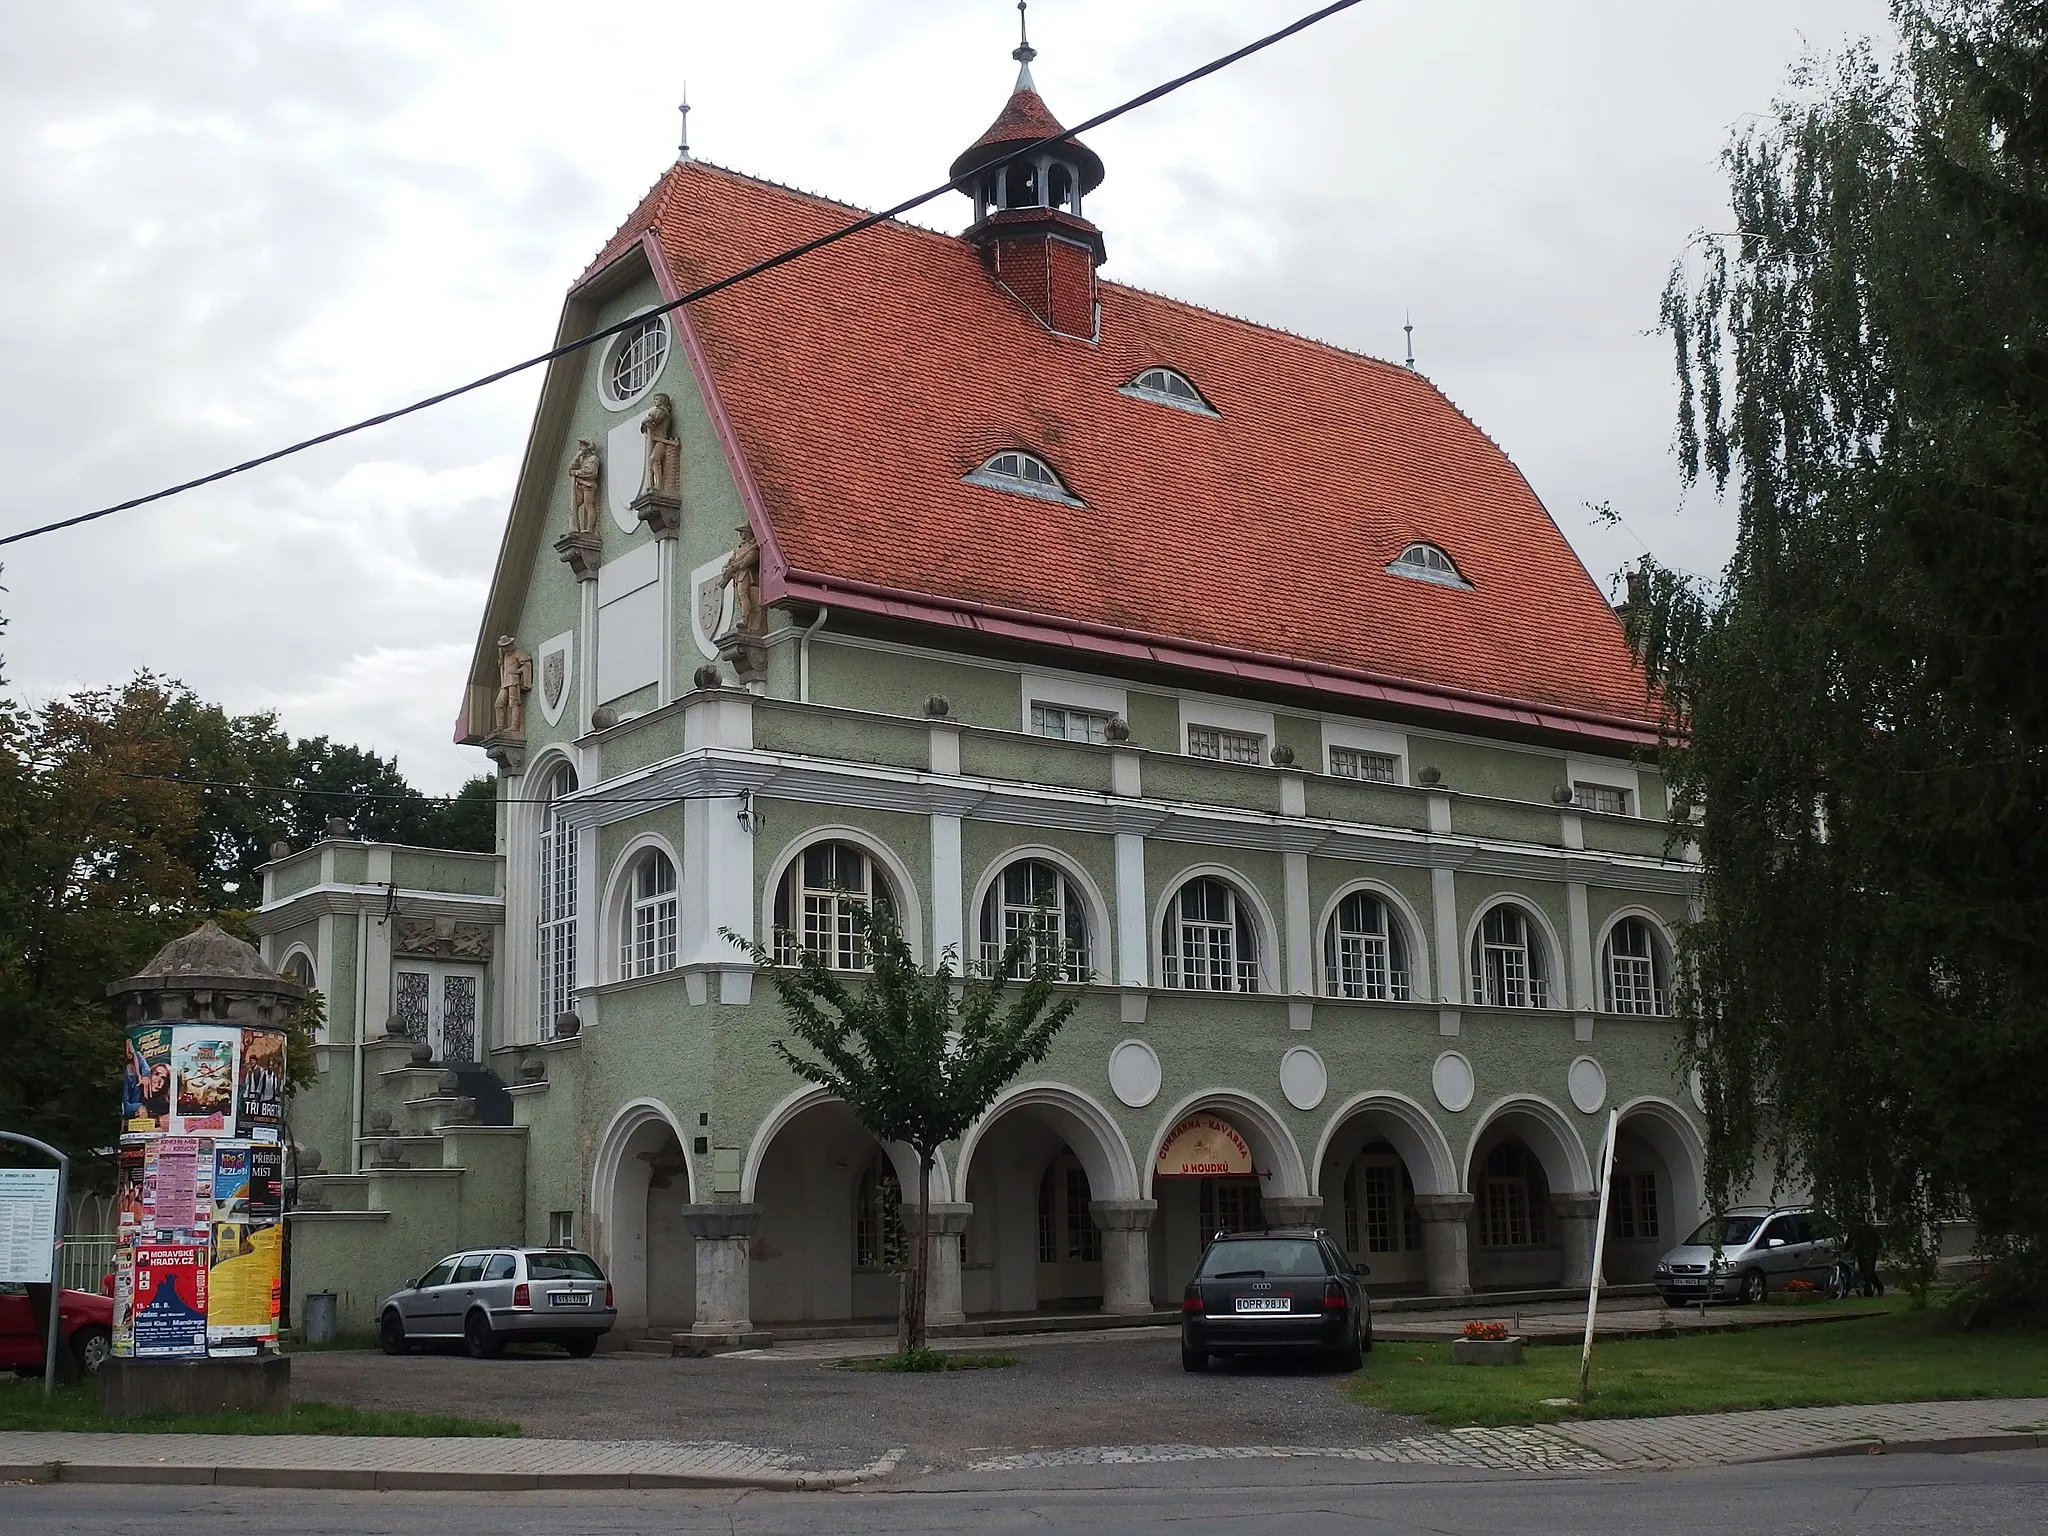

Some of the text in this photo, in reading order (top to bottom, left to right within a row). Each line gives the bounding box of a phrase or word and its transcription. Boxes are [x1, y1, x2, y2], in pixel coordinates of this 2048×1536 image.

[245, 1100, 259, 1115] TŘI
[1209, 1119, 1248, 1160] KAVÁRNA
[221, 1152, 246, 1161] KDO SI
[252, 1152, 280, 1165] PŘÍBĚHY
[252, 1165, 271, 1177] MÍST
[1183, 1160, 1229, 1173] U HOUDKŮ
[151, 1250, 194, 1258] MORAVSKÉ
[151, 1257, 194, 1266] HRADY.CZ
[1243, 1299, 1289, 1309] OPR 98JK
[173, 1319, 205, 1327] Mandrage
